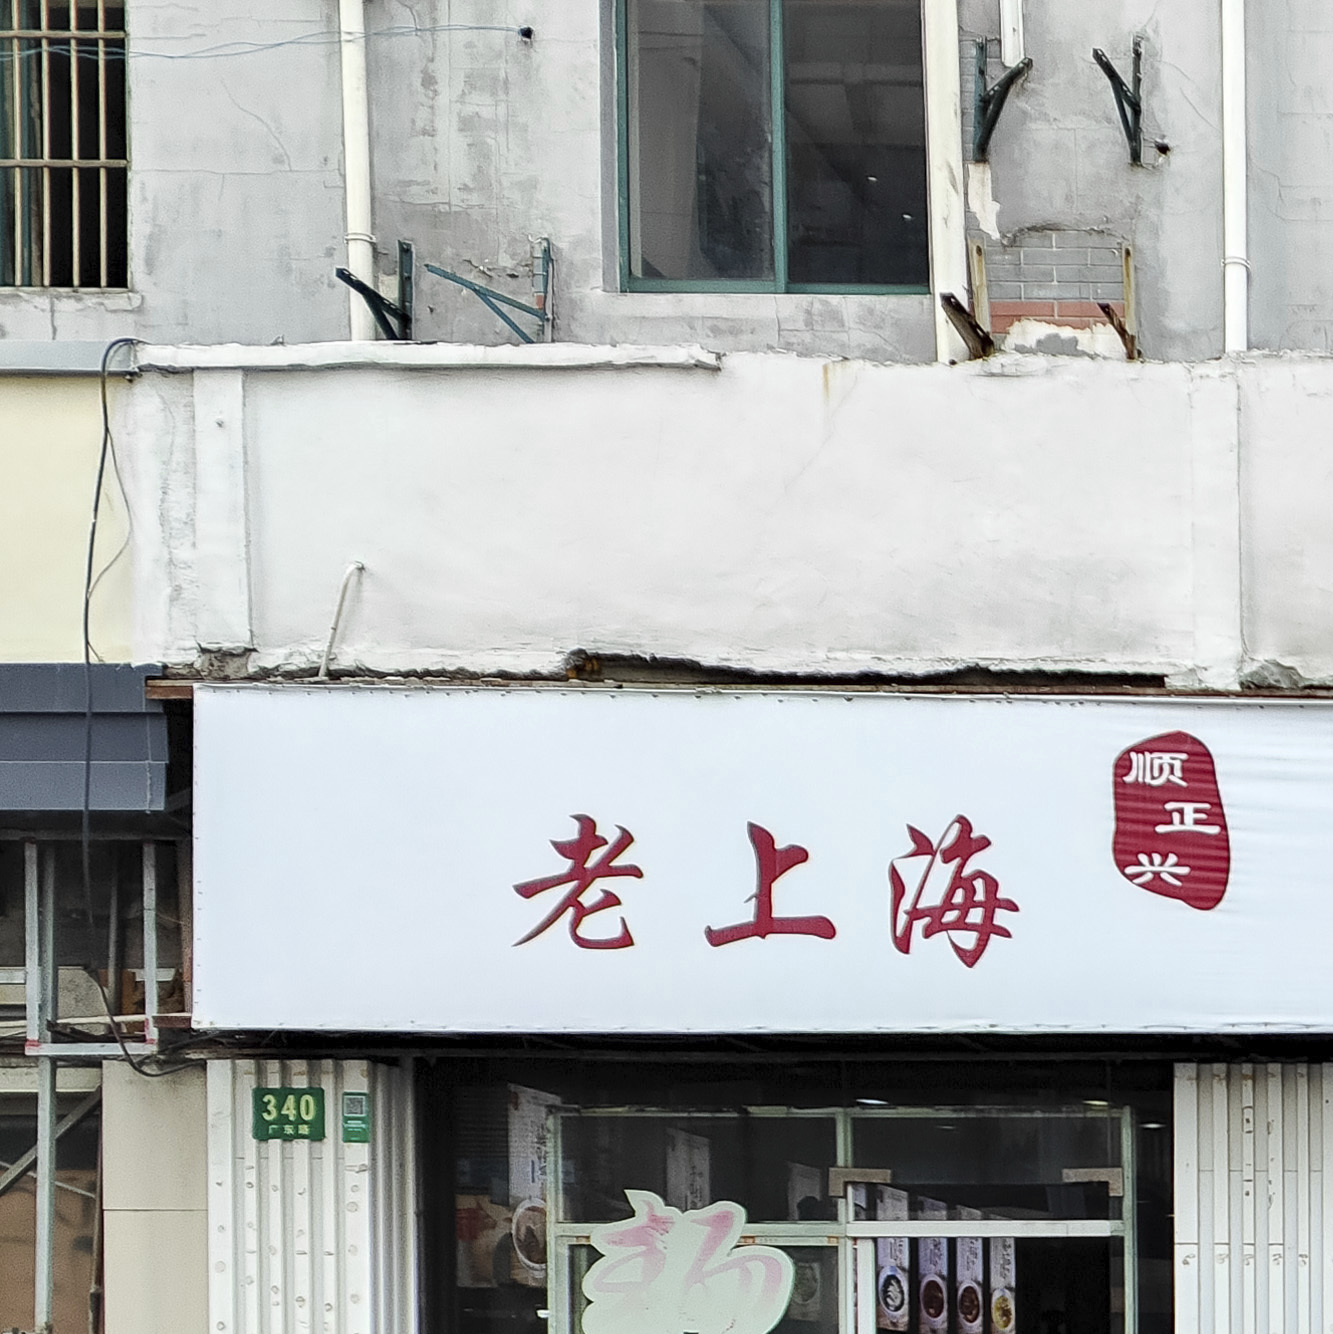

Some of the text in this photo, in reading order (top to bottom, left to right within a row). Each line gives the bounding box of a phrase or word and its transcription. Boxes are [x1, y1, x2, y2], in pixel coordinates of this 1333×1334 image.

[1122, 750, 1222, 887] 顺正兴
[511, 813, 1020, 968] 老上海
[261, 1094, 316, 1121] 340
[267, 1124, 311, 1136] 广东路
